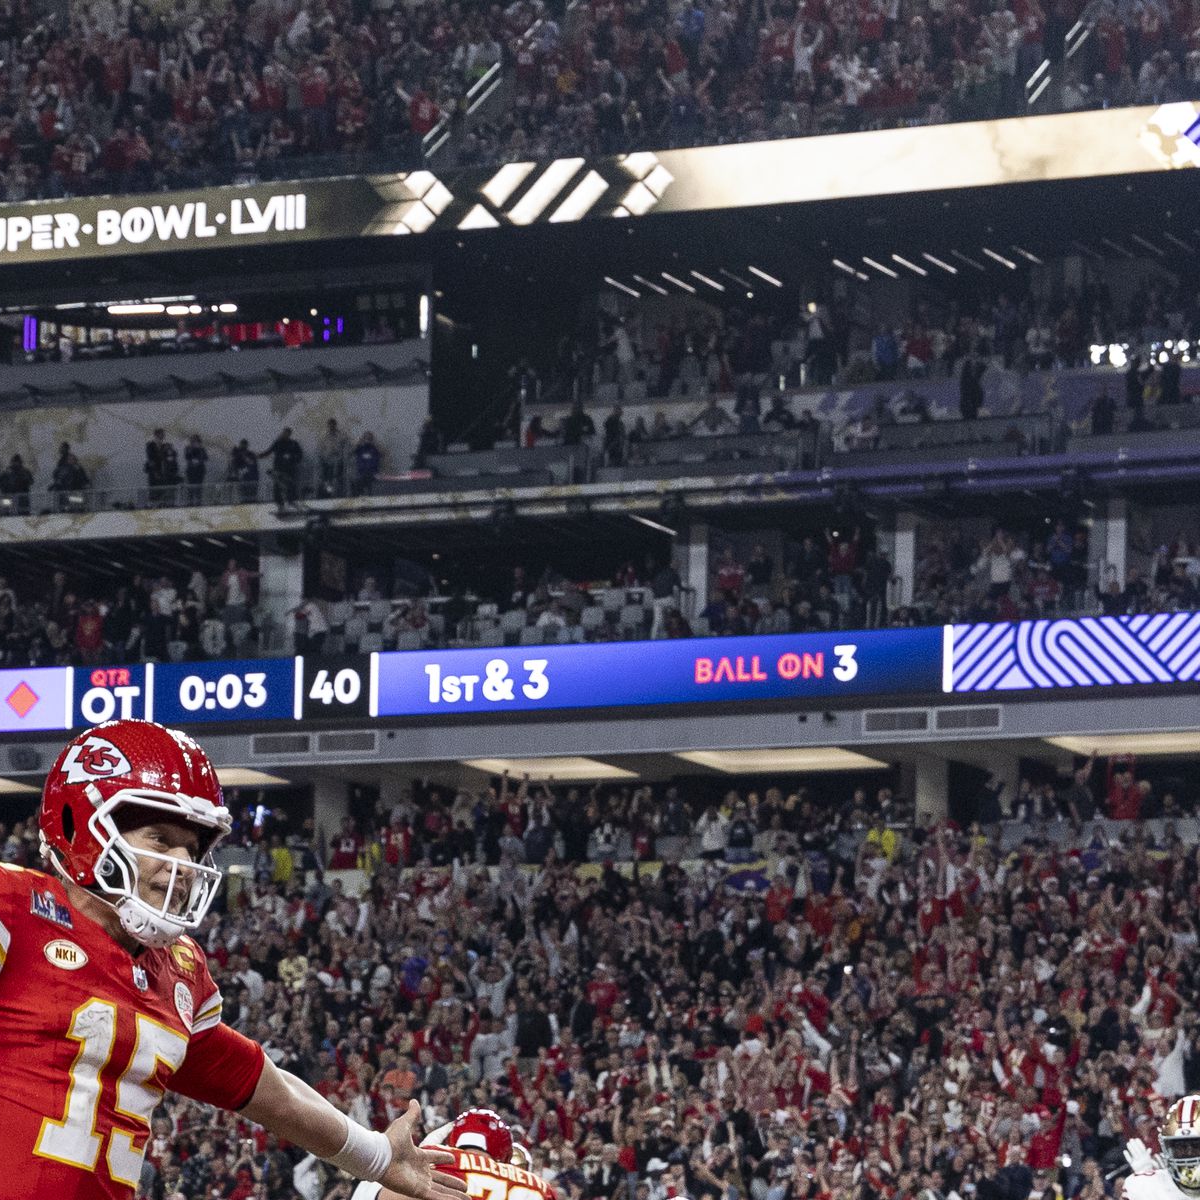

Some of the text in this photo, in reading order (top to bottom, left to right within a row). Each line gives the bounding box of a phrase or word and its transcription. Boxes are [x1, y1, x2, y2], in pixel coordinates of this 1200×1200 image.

[97, 202, 217, 245] BOWL
[231, 194, 307, 235] LVIII
[90, 668, 131, 687] QTR
[522, 658, 550, 700] 3
[694, 644, 858, 684] BALL ON 3
[80, 685, 141, 724] OT
[179, 672, 268, 711] 0:03
[308, 668, 361, 705] 40
[73, 744, 122, 776] KC
[55, 946, 77, 963] NKH
[32, 996, 189, 1188] 15
